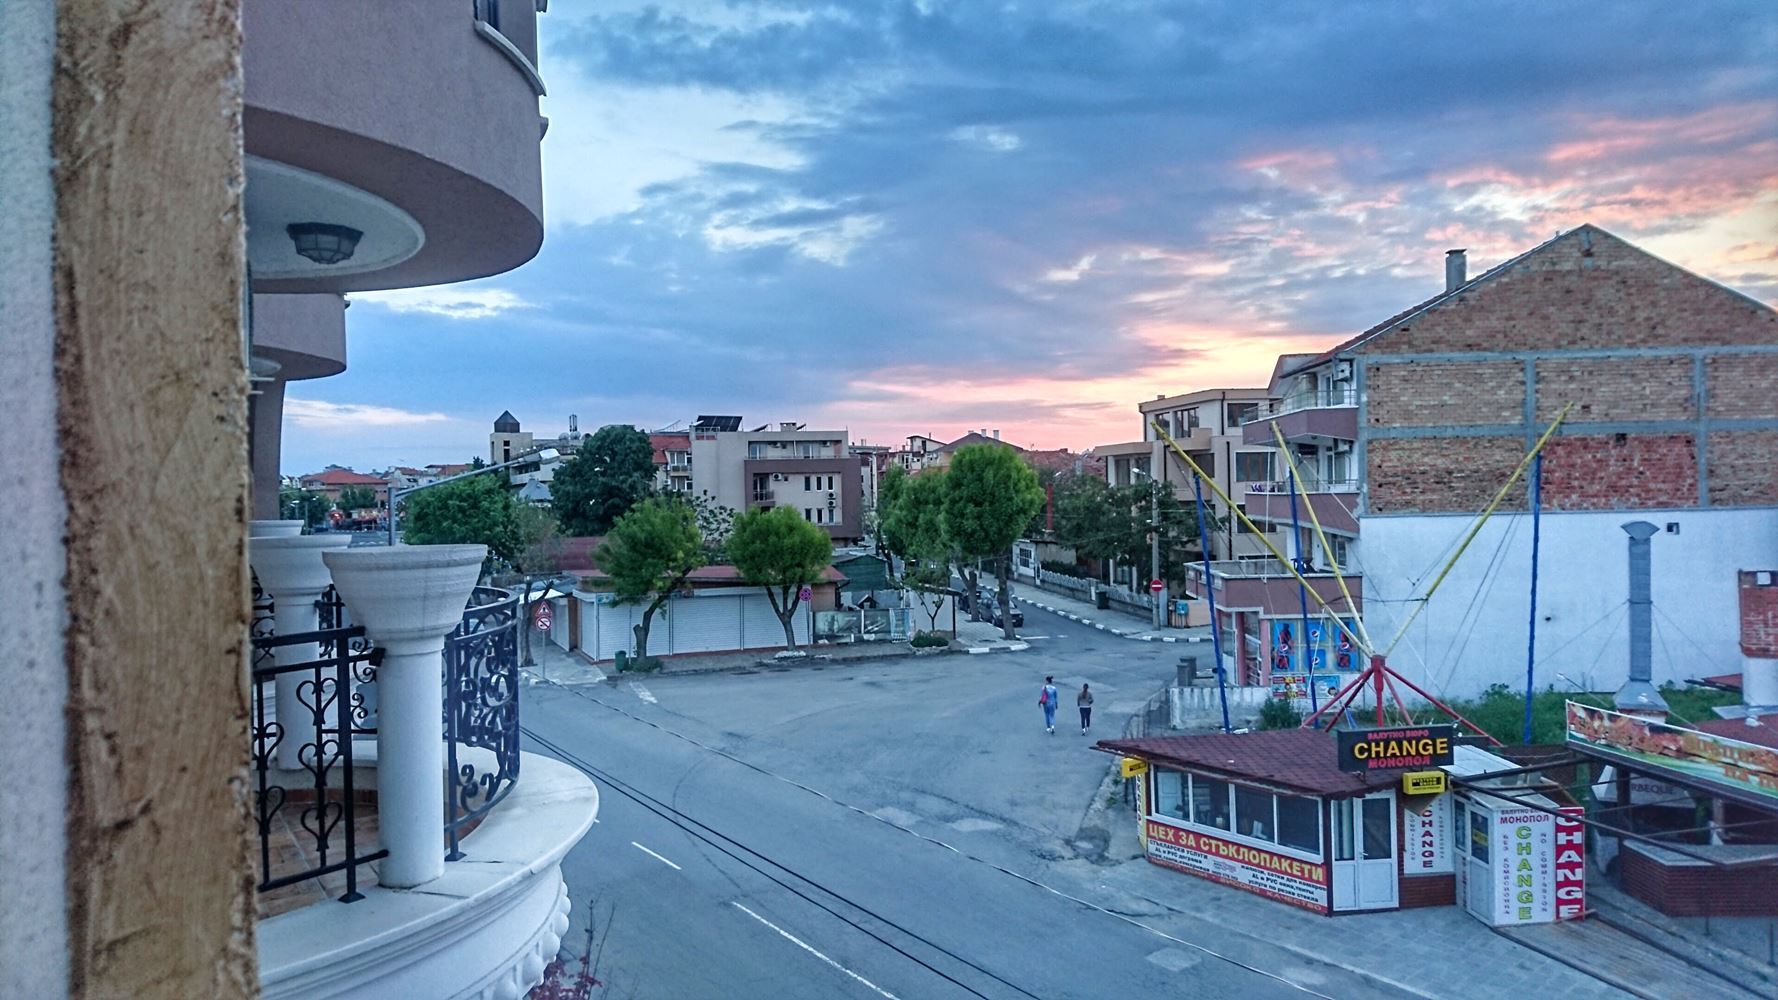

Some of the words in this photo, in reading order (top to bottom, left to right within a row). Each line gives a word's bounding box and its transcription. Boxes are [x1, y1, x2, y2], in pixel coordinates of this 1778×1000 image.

[1367, 730, 1405, 740] ВАЛУТНО
[1406, 729, 1430, 738] БЮРО
[1354, 738, 1449, 759] CHANGE
[1368, 755, 1431, 769] МОНОПОЛ
[1500, 814, 1549, 825] МОНОПОЛ
[1421, 809, 1434, 868] CHANGE
[1149, 823, 1175, 842] ЦЕХ
[1179, 830, 1197, 848] ЗА
[1200, 837, 1323, 882] СТЪКЛОПАКЕТИ
[1167, 849, 1178, 858] PVC
[1515, 825, 1534, 921] CHANGE
[1555, 813, 1583, 918] CHANGE
[1266, 876, 1278, 885] PVC
